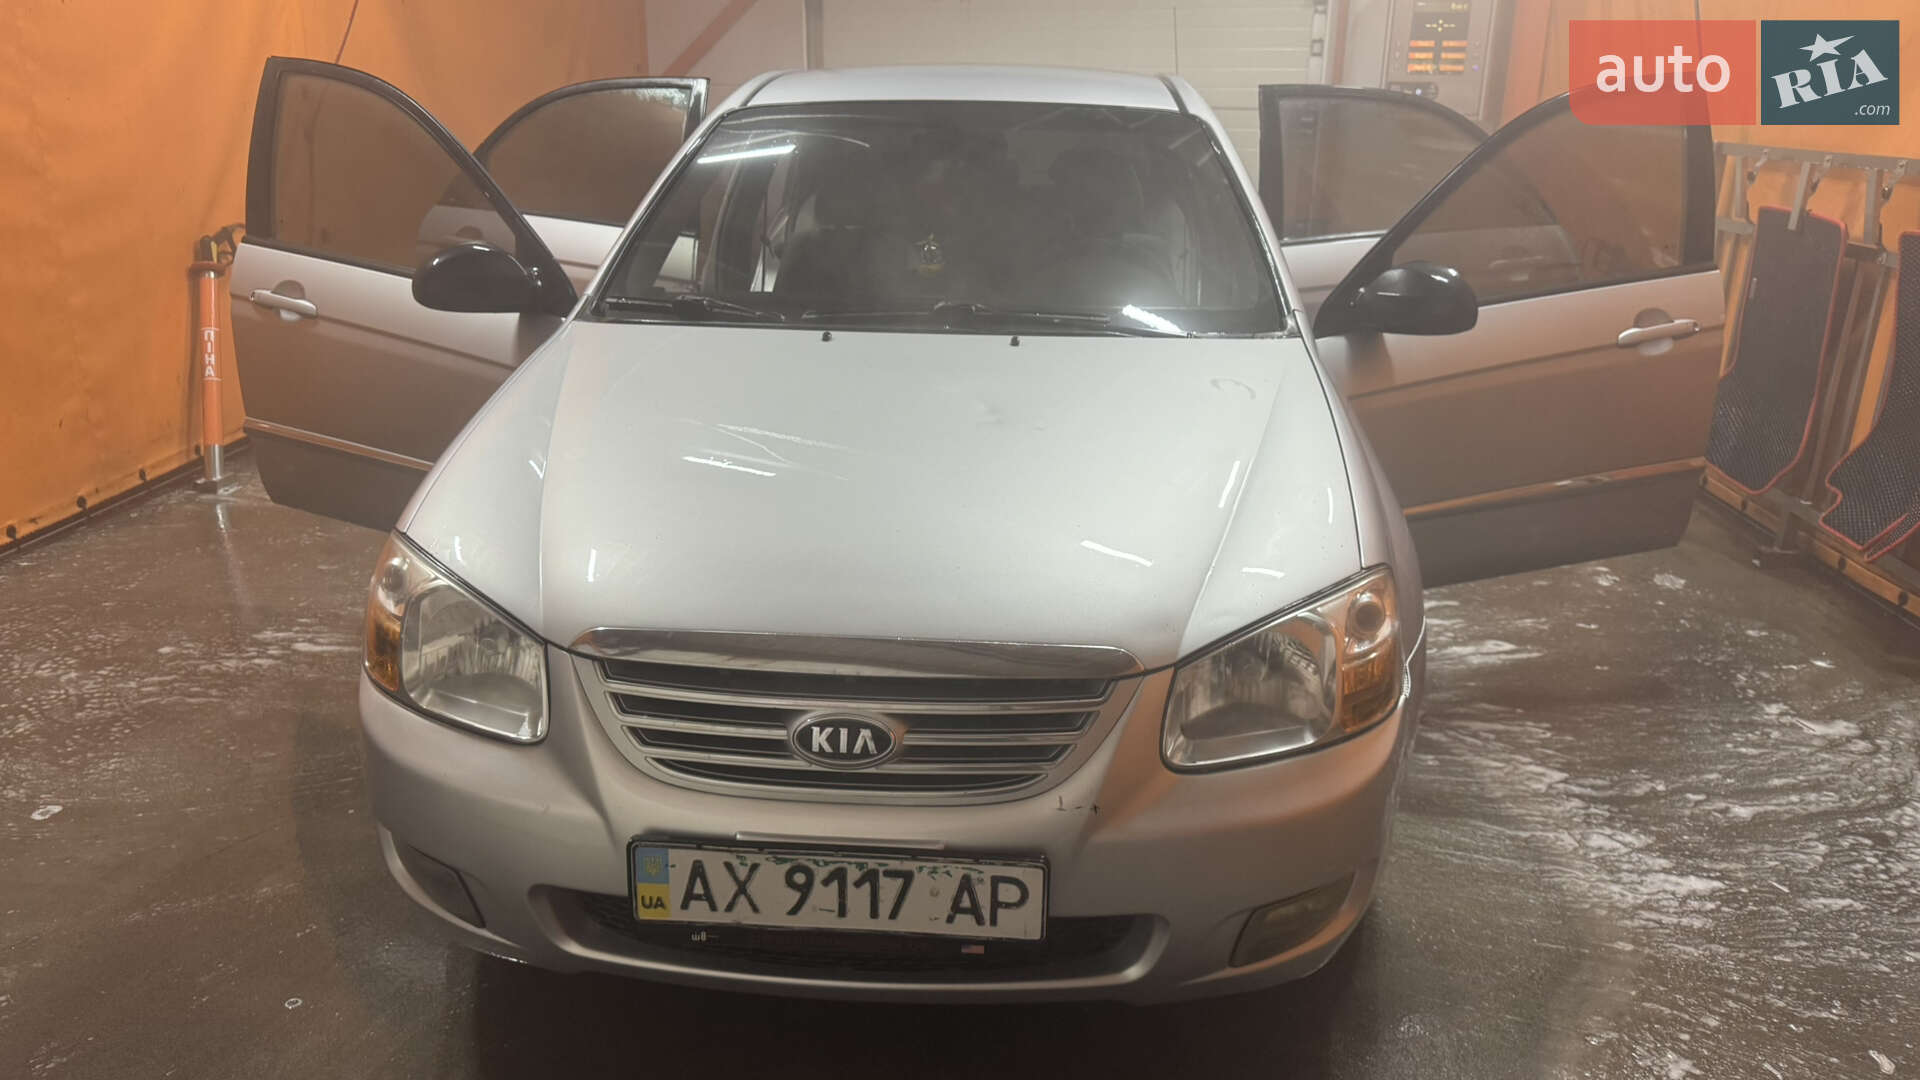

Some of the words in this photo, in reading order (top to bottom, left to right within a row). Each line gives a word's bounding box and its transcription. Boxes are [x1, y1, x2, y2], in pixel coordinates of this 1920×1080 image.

[203, 329, 216, 377] ПІНА
[811, 726, 878, 754] KIA
[641, 895, 667, 910] UA
[680, 859, 761, 914] AX
[784, 862, 915, 921] 9117
[945, 872, 1030, 927] AP
